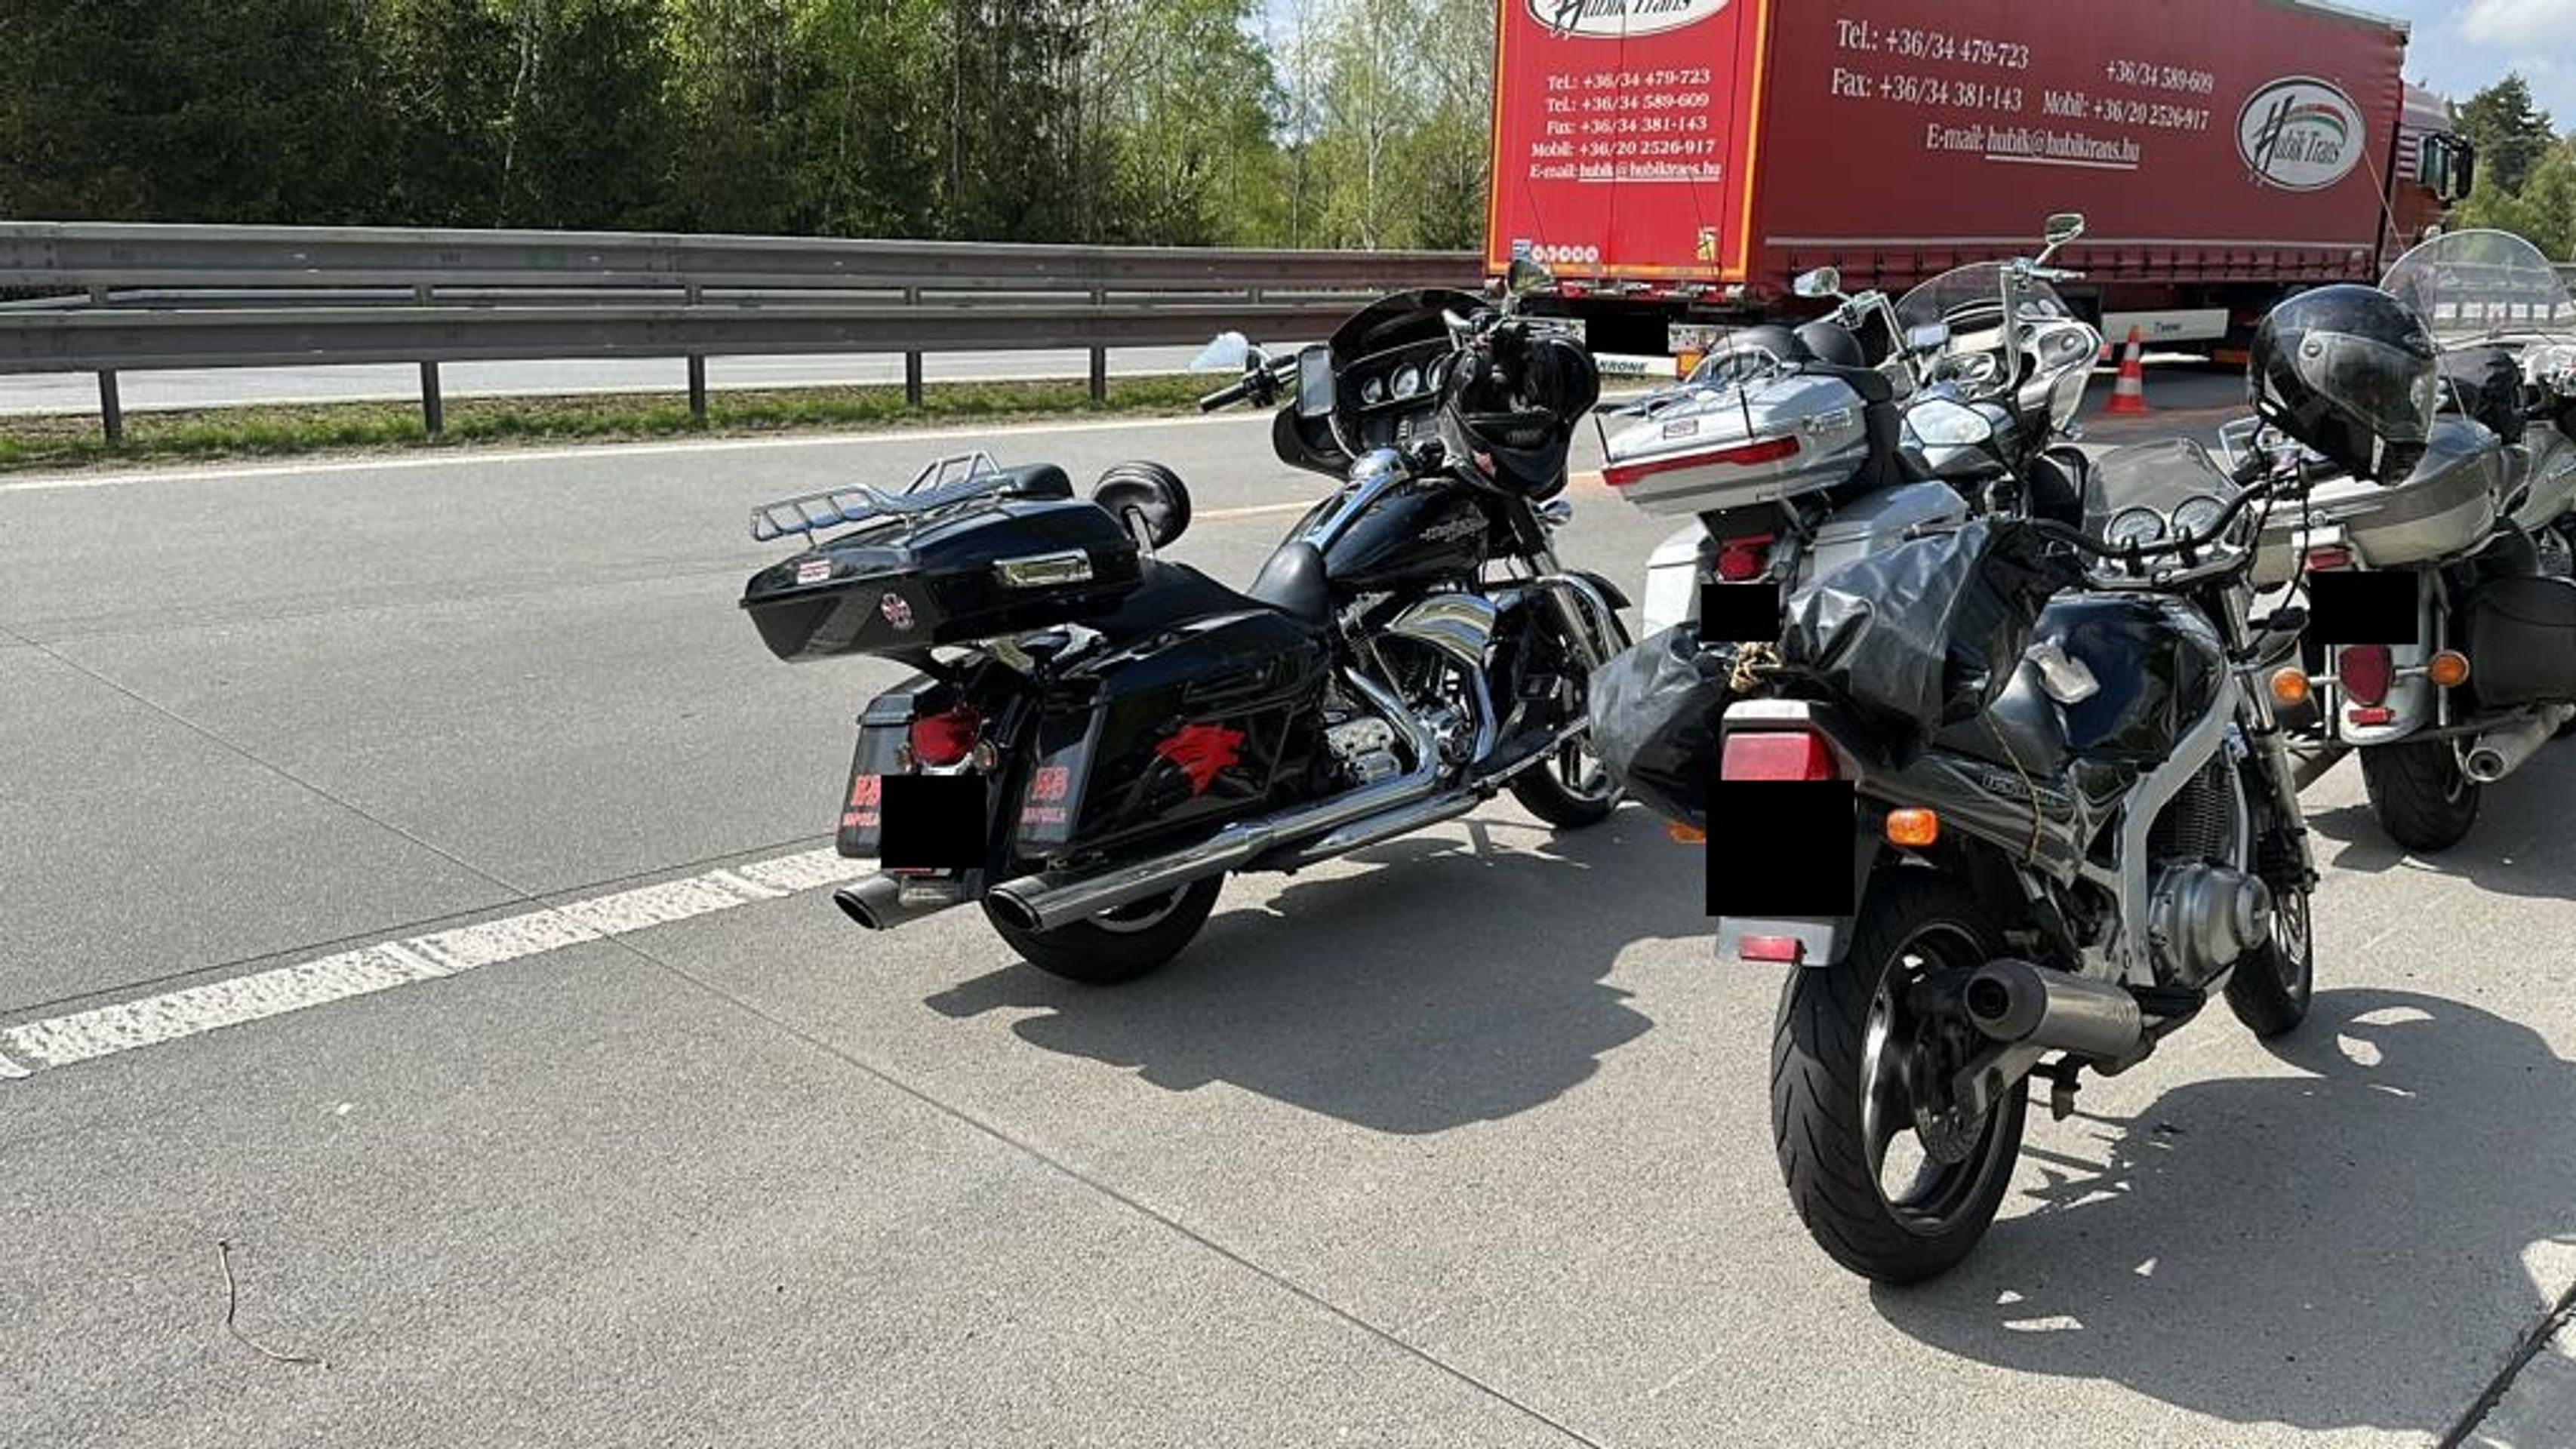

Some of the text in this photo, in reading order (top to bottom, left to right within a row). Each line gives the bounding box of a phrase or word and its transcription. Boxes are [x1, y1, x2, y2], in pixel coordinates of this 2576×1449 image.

[1837, 20, 2029, 69] Tel.: +36/34 479-723
[1547, 68, 1710, 90] Tel.: +36/34 479-723
[1832, 68, 2022, 112] Fax: +36/34 381-143
[1546, 93, 1710, 112] Tel.: +36/34 589-609
[2094, 99, 2148, 125] +36/20
[1581, 117, 1636, 134] +36/34
[1641, 115, 1707, 132] 381-143
[1927, 123, 1984, 150] E-mail:
[1531, 140, 1715, 158] Mobil: +36/20 2526-917
[1530, 163, 1577, 178] E-mail:
